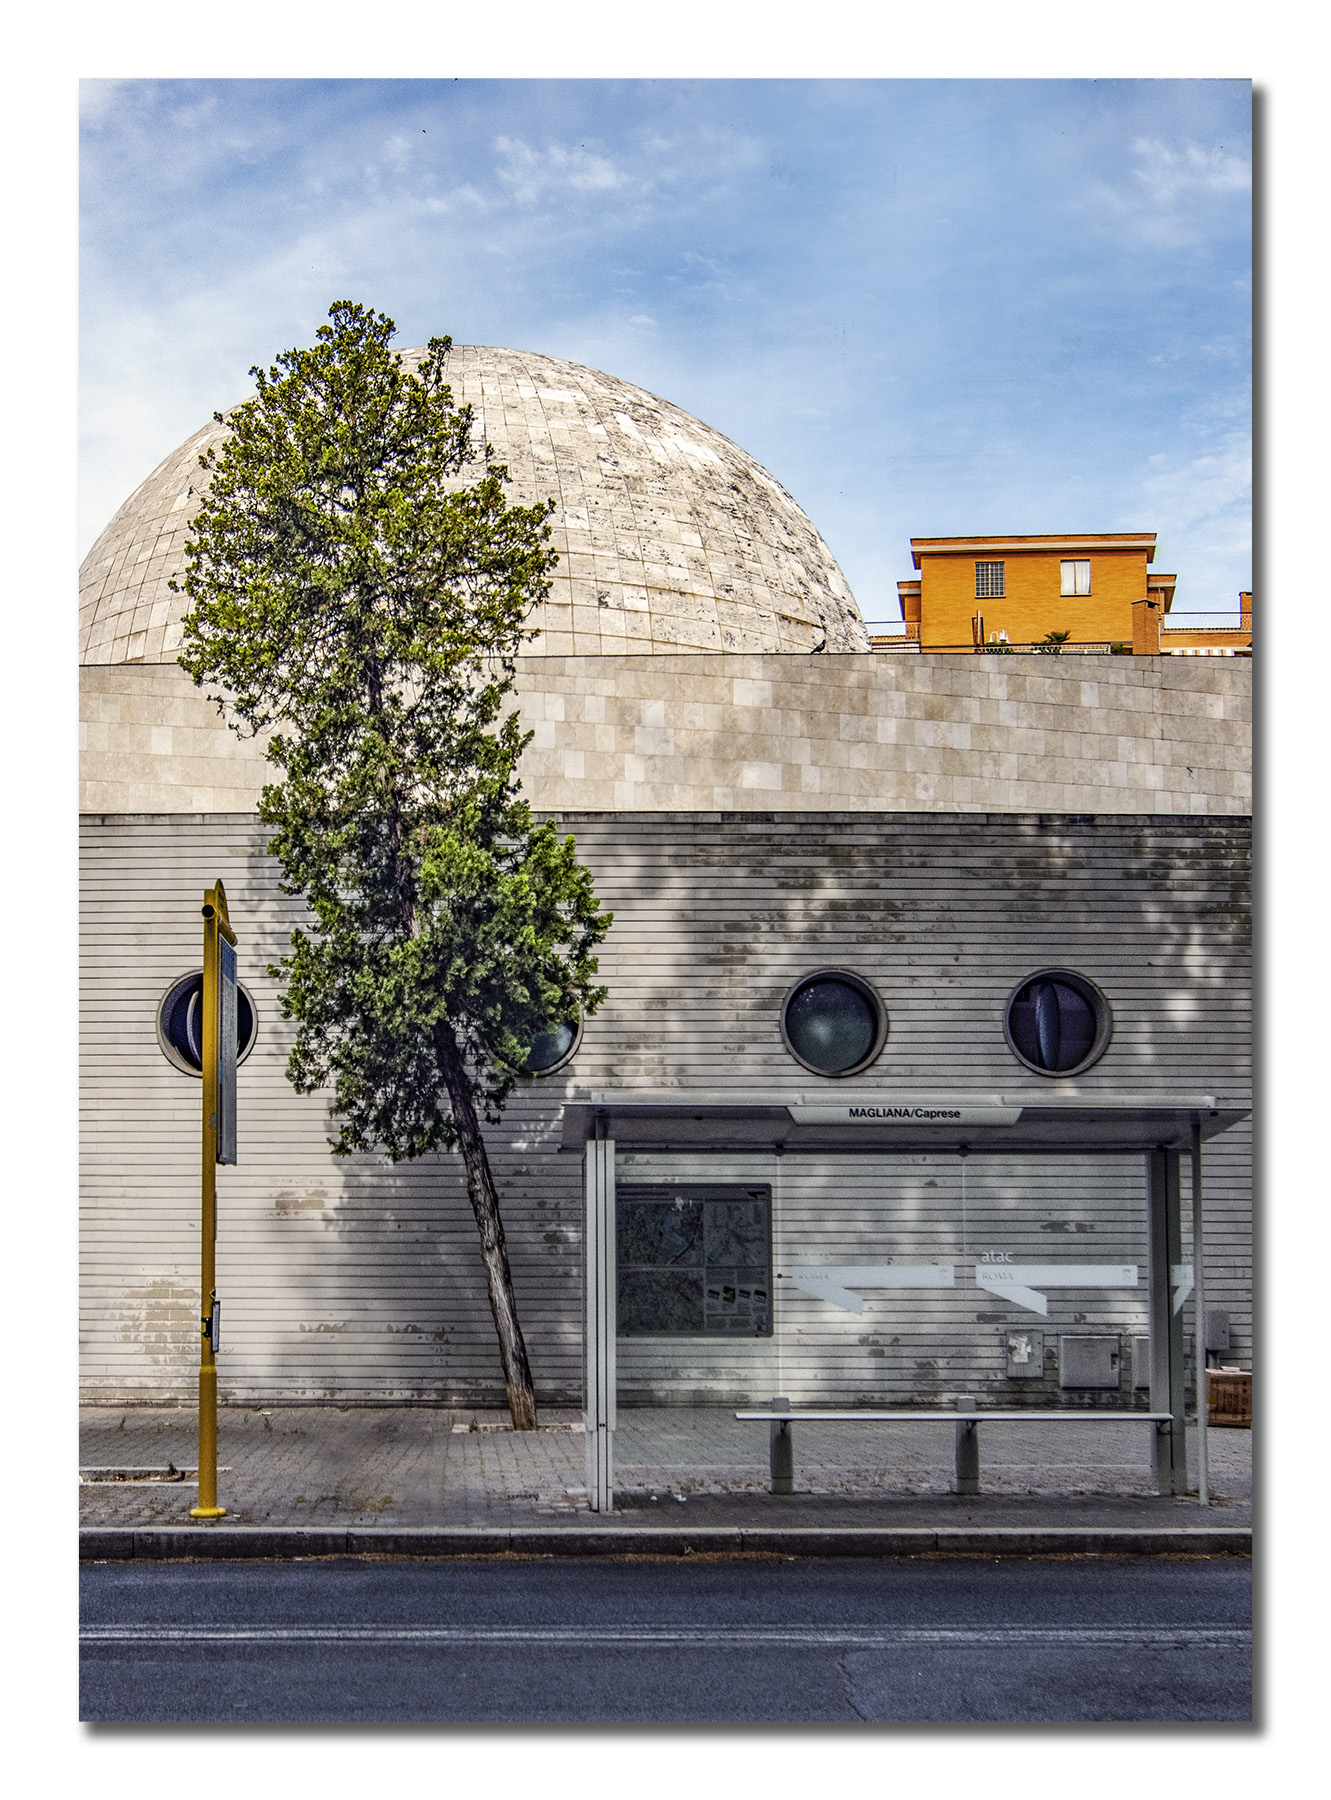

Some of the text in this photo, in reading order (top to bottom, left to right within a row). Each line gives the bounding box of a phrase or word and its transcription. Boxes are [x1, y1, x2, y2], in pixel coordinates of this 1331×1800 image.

[848, 1108, 961, 1119] MAGLIANA/Caprese
[981, 1250, 1014, 1263] atac
[981, 1271, 1014, 1281] ROMA
